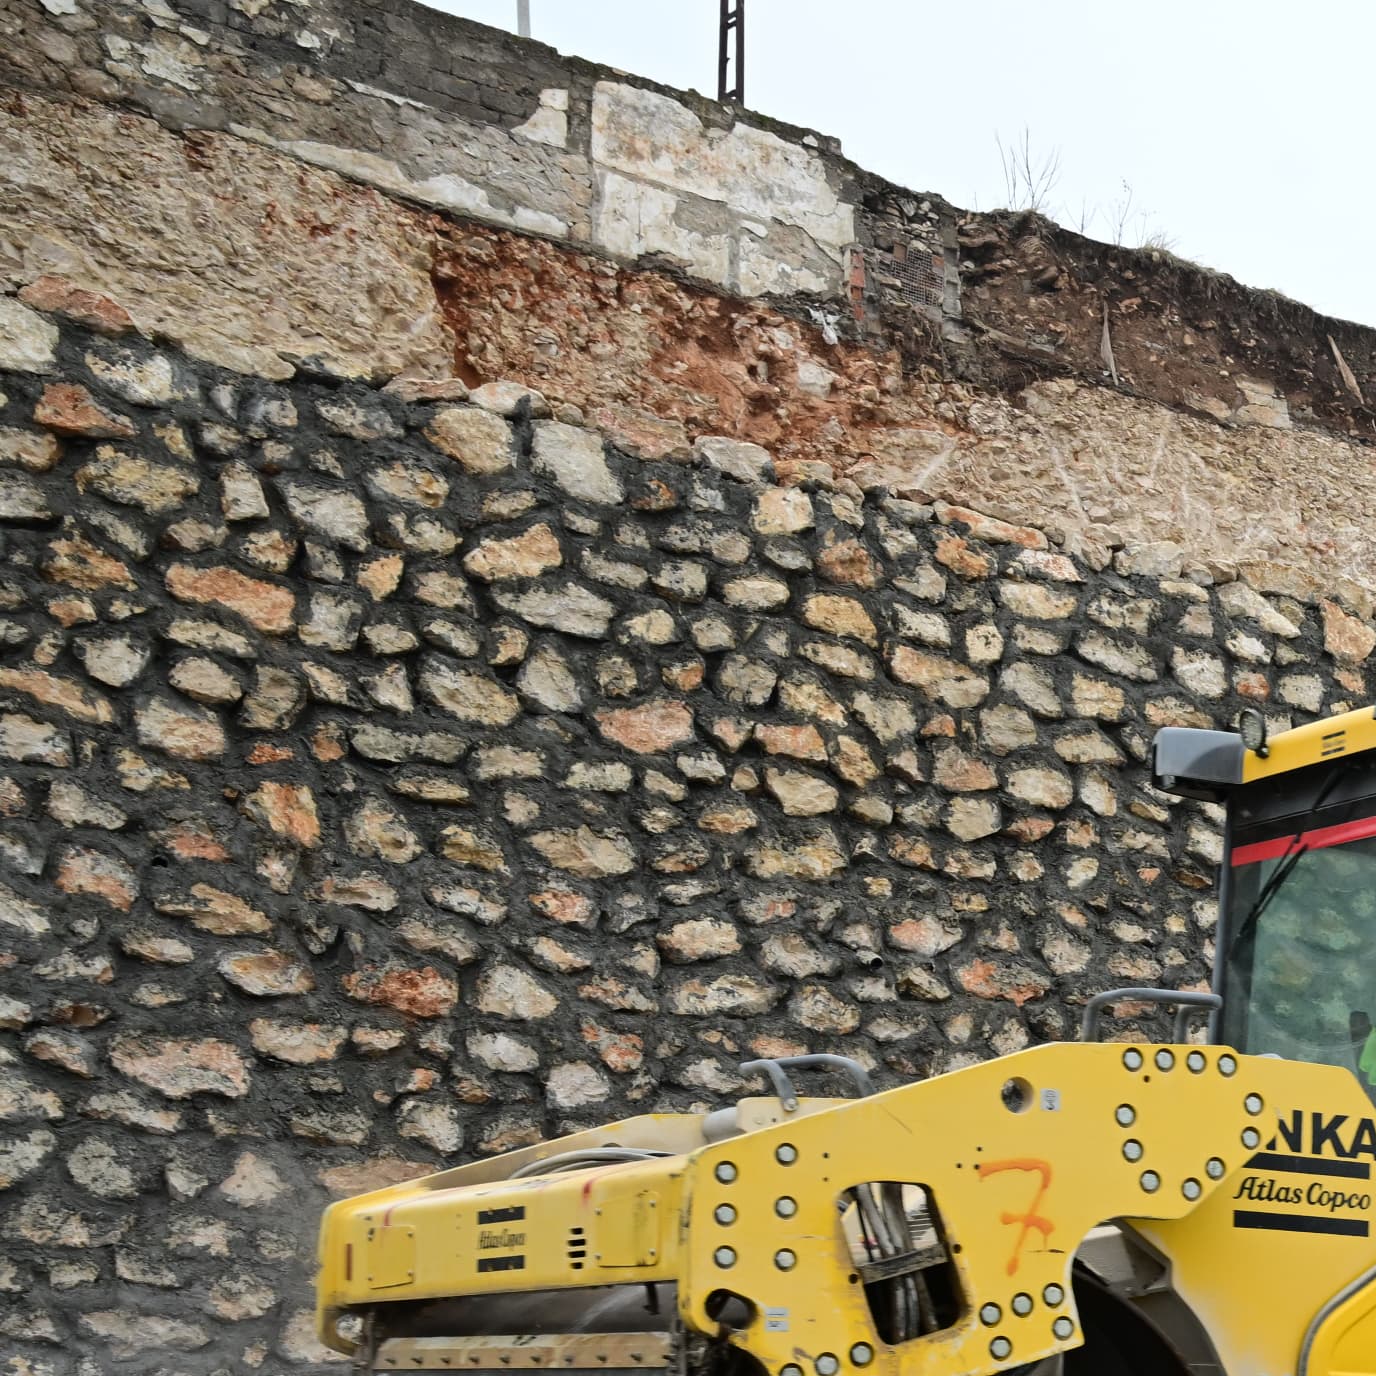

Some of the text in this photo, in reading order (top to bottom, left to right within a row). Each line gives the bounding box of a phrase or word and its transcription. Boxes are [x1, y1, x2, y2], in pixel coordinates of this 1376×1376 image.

[977, 1158, 1055, 1276] 7
[1233, 1176, 1371, 1212] Atlas Copco
